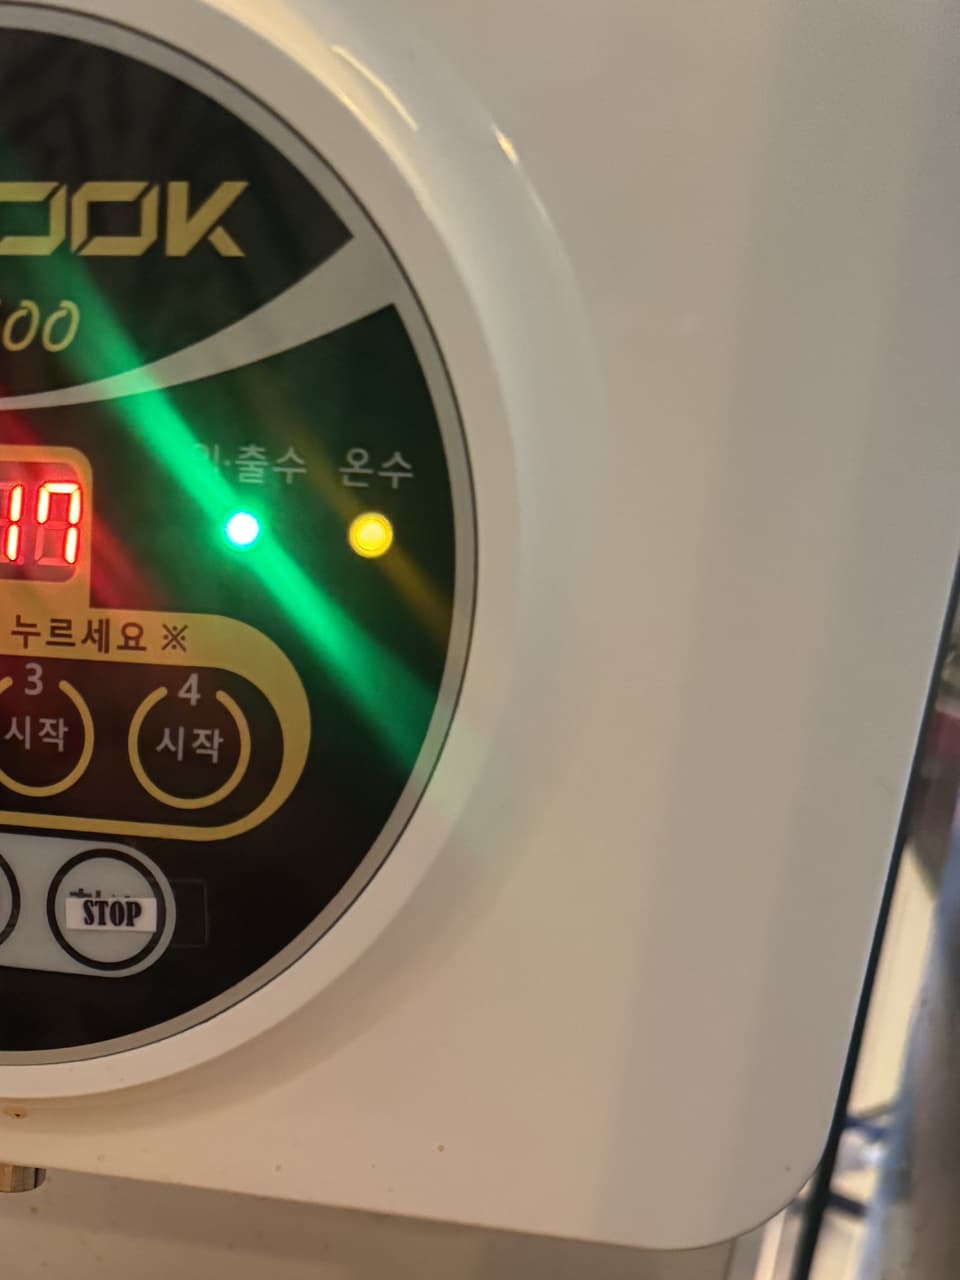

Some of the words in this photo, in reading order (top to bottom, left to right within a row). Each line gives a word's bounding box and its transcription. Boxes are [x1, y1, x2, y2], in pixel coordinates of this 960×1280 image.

[338, 446, 414, 489] 온수
[10, 614, 147, 654] 누르세요
[23, 662, 44, 696] 3
[177, 672, 201, 706] 4
[3, 714, 69, 753] 시작
[155, 725, 224, 764] 시작
[82, 899, 143, 927] STOP
